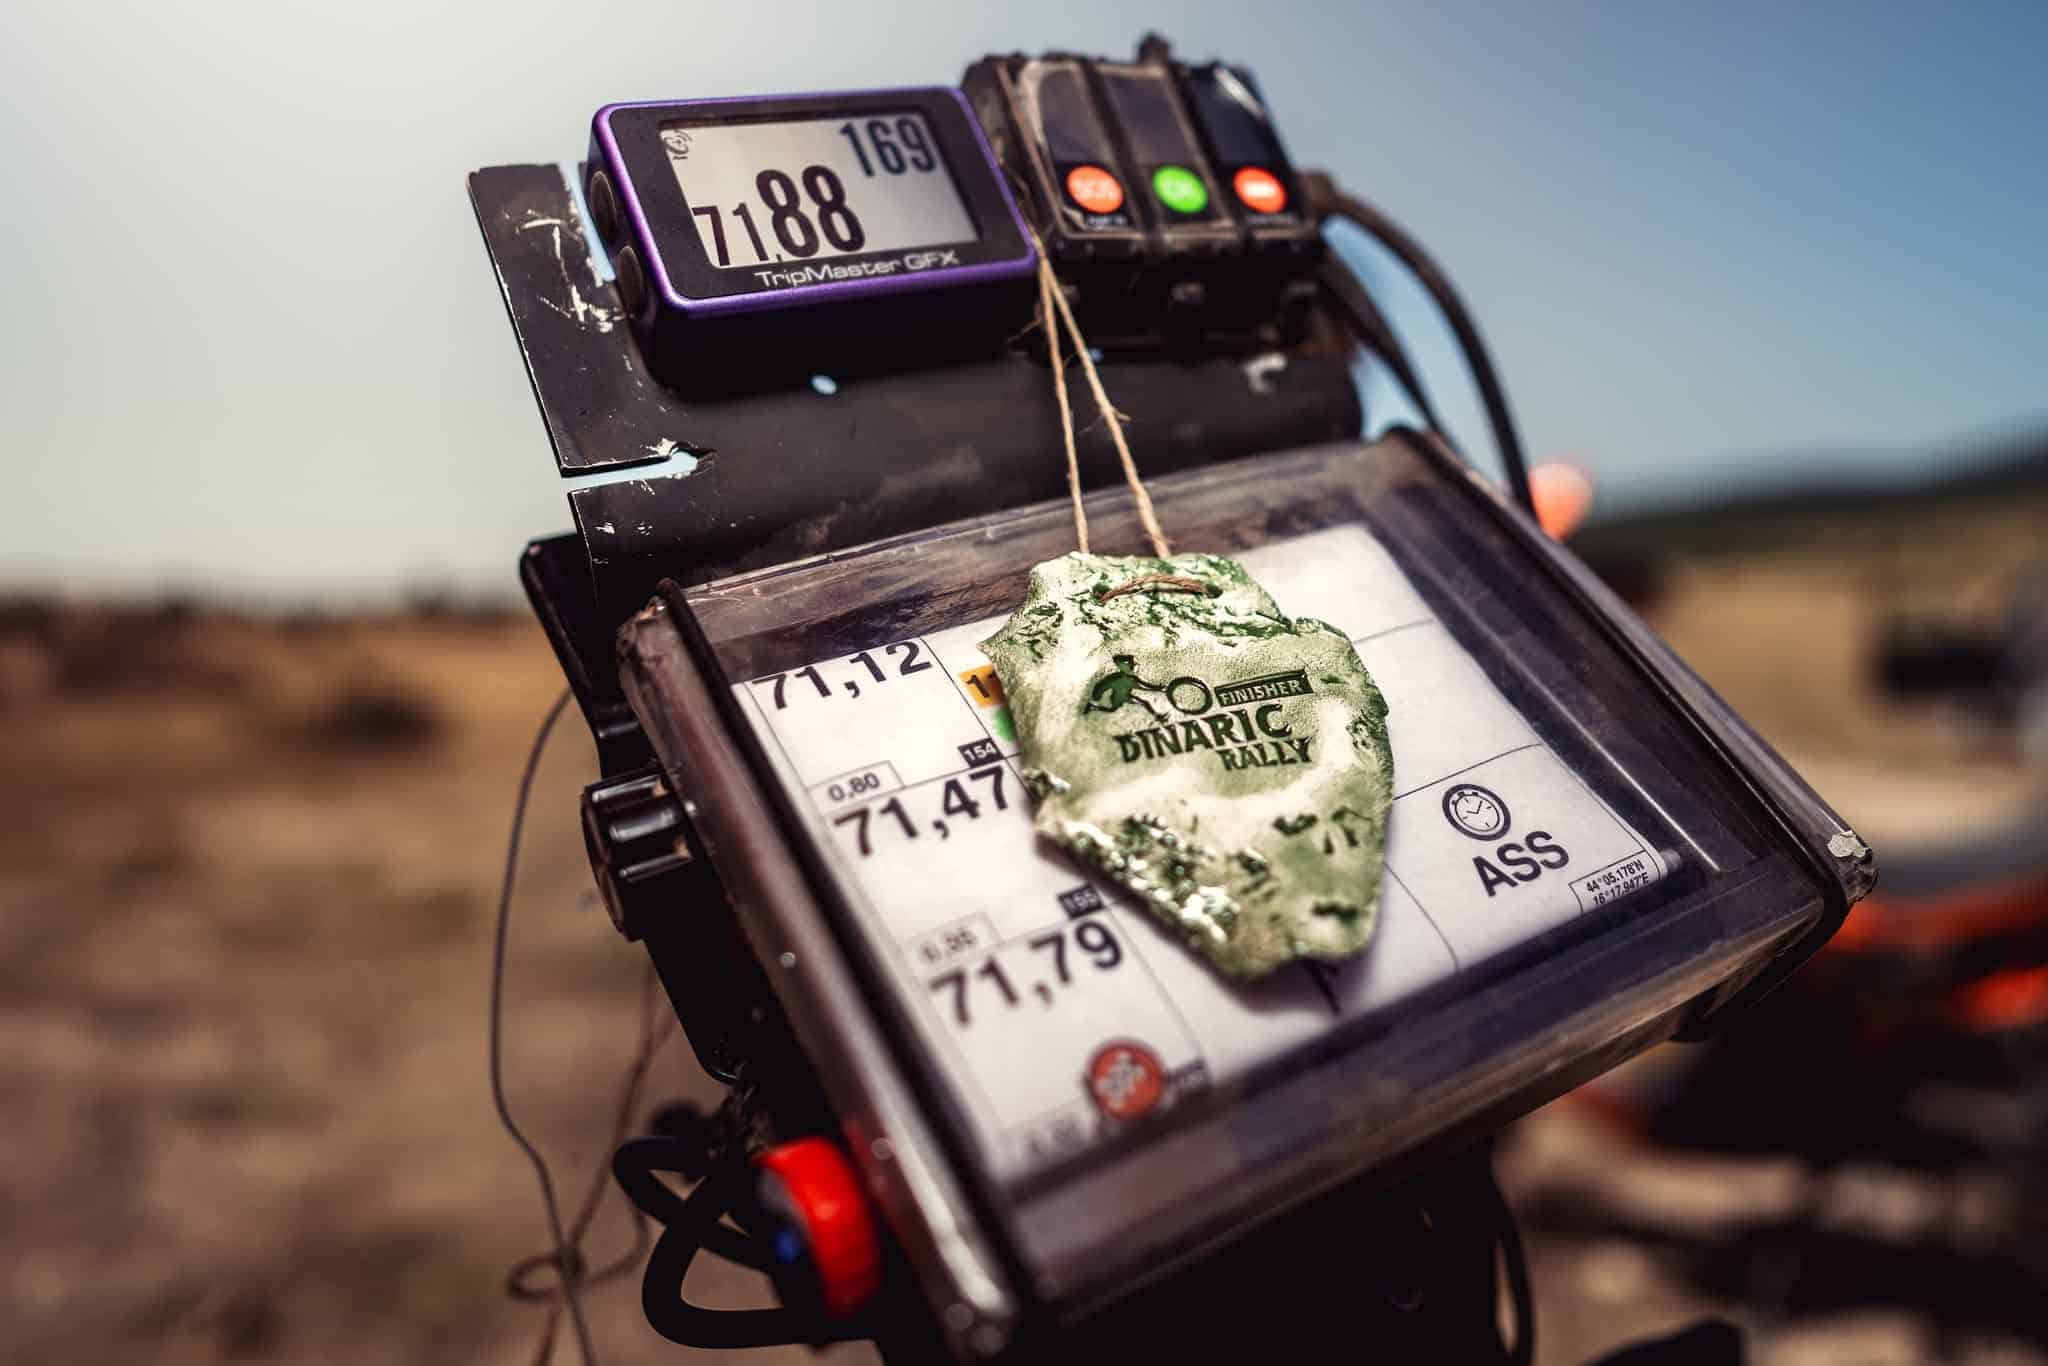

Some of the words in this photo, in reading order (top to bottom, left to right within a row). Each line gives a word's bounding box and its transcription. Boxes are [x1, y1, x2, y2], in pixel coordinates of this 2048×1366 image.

[840, 119, 936, 177] 169
[754, 259, 902, 288] TripMaster
[903, 249, 960, 270] GFX
[752, 641, 932, 710] 71,12
[1218, 679, 1303, 707] FINISHER
[963, 740, 998, 761] 154
[1113, 703, 1293, 764] DINARIC
[1216, 735, 1313, 771] RALLY
[827, 772, 881, 802] 0,80
[834, 764, 1008, 858] 71,47
[1472, 831, 1570, 898] ASS
[929, 919, 1124, 1027] 71,79
